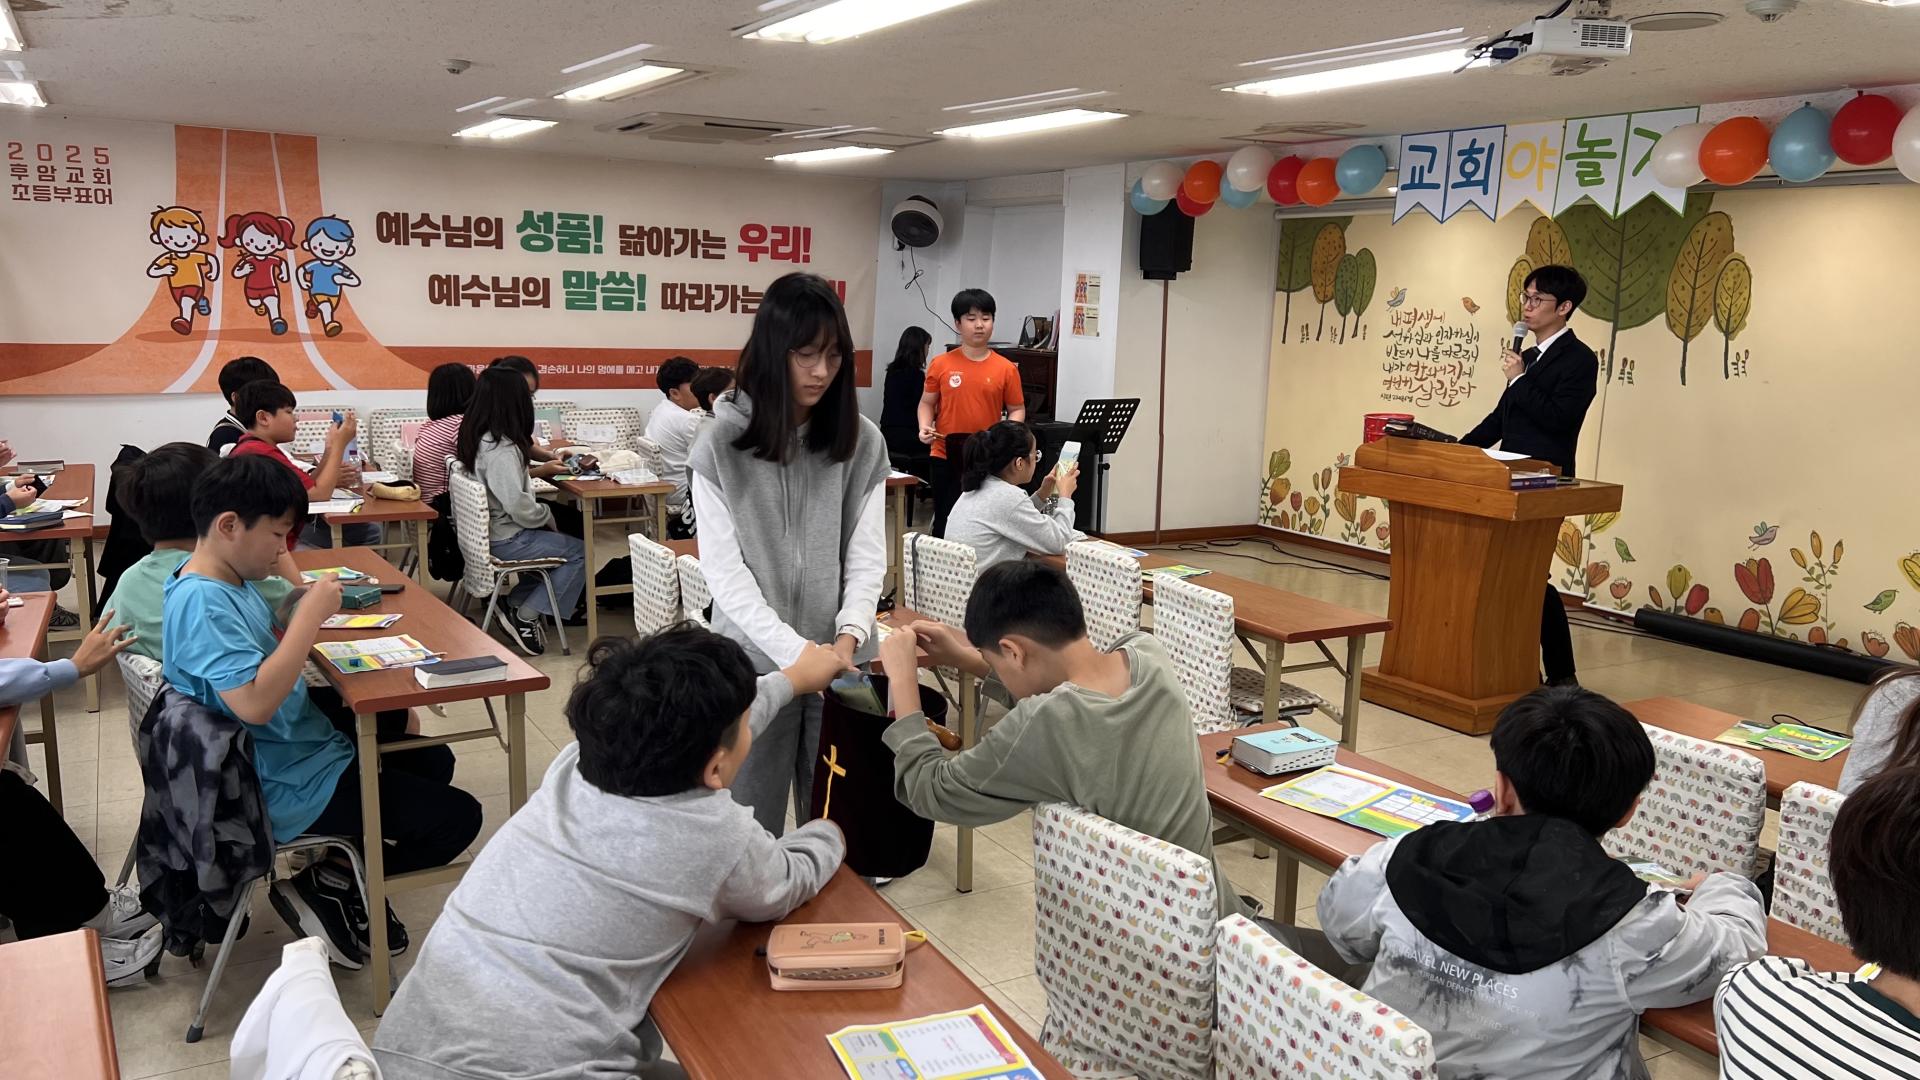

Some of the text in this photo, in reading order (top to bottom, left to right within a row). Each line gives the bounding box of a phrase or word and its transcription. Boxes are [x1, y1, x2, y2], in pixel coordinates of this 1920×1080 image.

[8, 141, 110, 165] 2025
[1400, 136, 1558, 195] 교회야
[10, 163, 112, 185] 후암교회
[375, 210, 812, 263] 예수님의 성품! 닮아가는 우리!
[428, 270, 764, 314] 예수님의 말씀! 따라가는
[1386, 343, 1479, 363] 반드시 나를 따르리니
[538, 364, 575, 374] 겸손하니
[577, 364, 595, 374] 나의
[597, 364, 624, 375] 멍에를
[626, 365, 644, 375] 메고
[1382, 361, 1405, 374] 내가
[1383, 375, 1477, 407] 영원히 살리로다
[1440, 961, 1471, 981] NEW
[1471, 972, 1519, 999] PLACES
